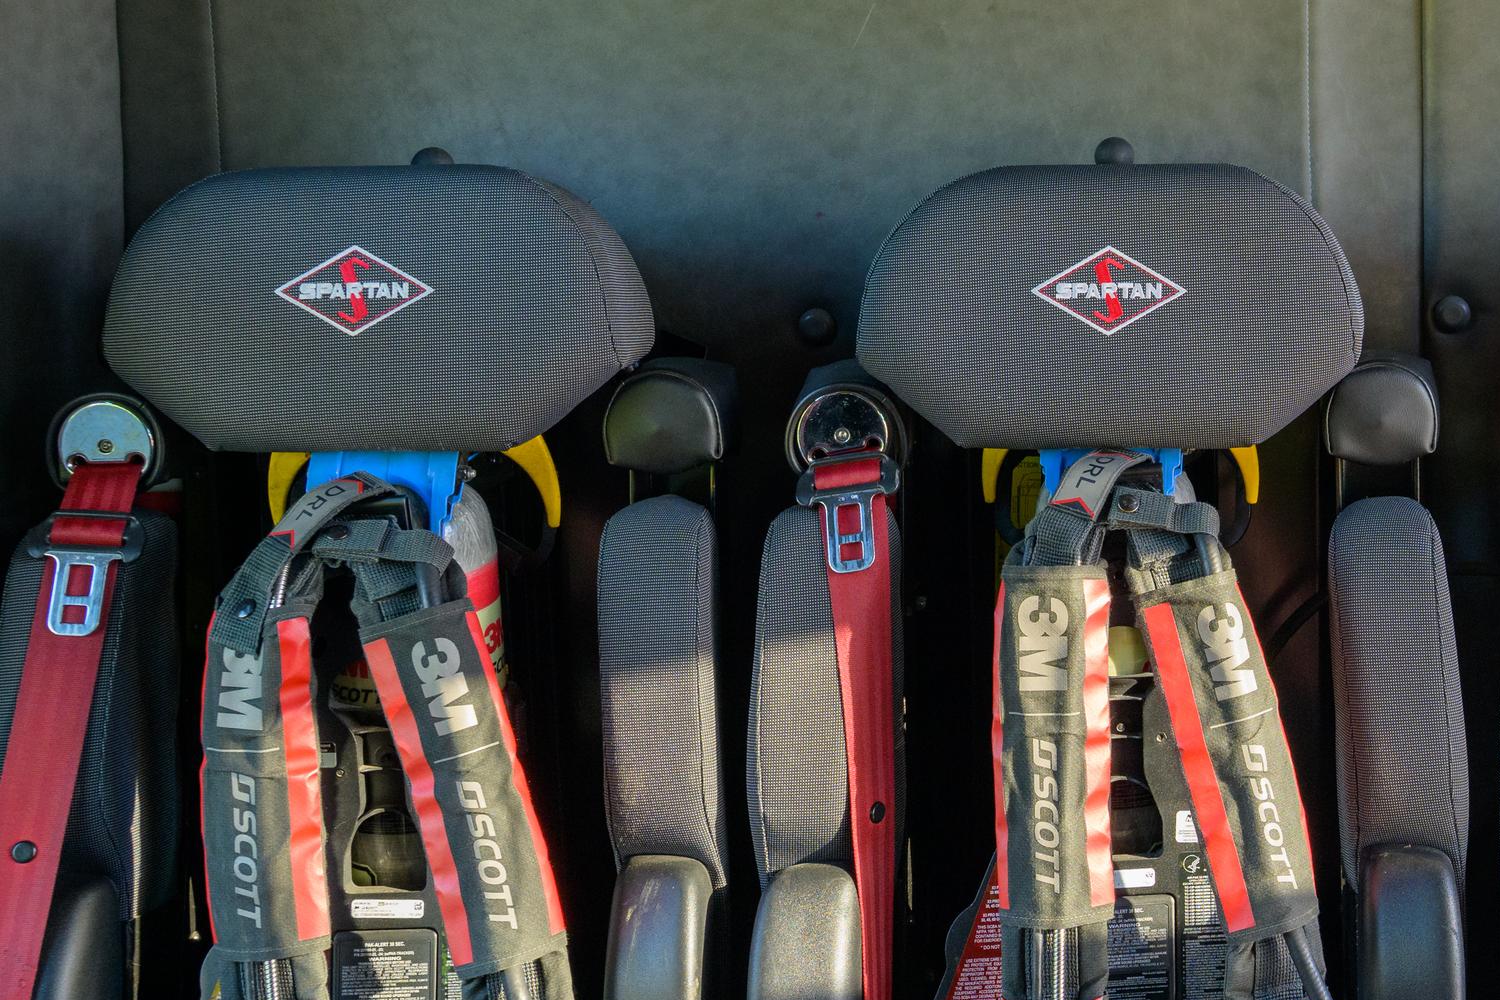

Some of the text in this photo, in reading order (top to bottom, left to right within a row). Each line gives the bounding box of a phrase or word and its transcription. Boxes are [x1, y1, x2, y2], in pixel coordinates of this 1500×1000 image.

[299, 282, 410, 299] SPARTAN
[1055, 282, 1162, 300] SPARTAN
[295, 484, 346, 521] DRL
[1075, 455, 1115, 489] DRL
[411, 637, 518, 930] 3M SCOTT
[1017, 595, 1069, 894] 3M SCOTT
[1195, 602, 1299, 890] 3M SCOTT
[233, 807, 262, 929] SCOTT
